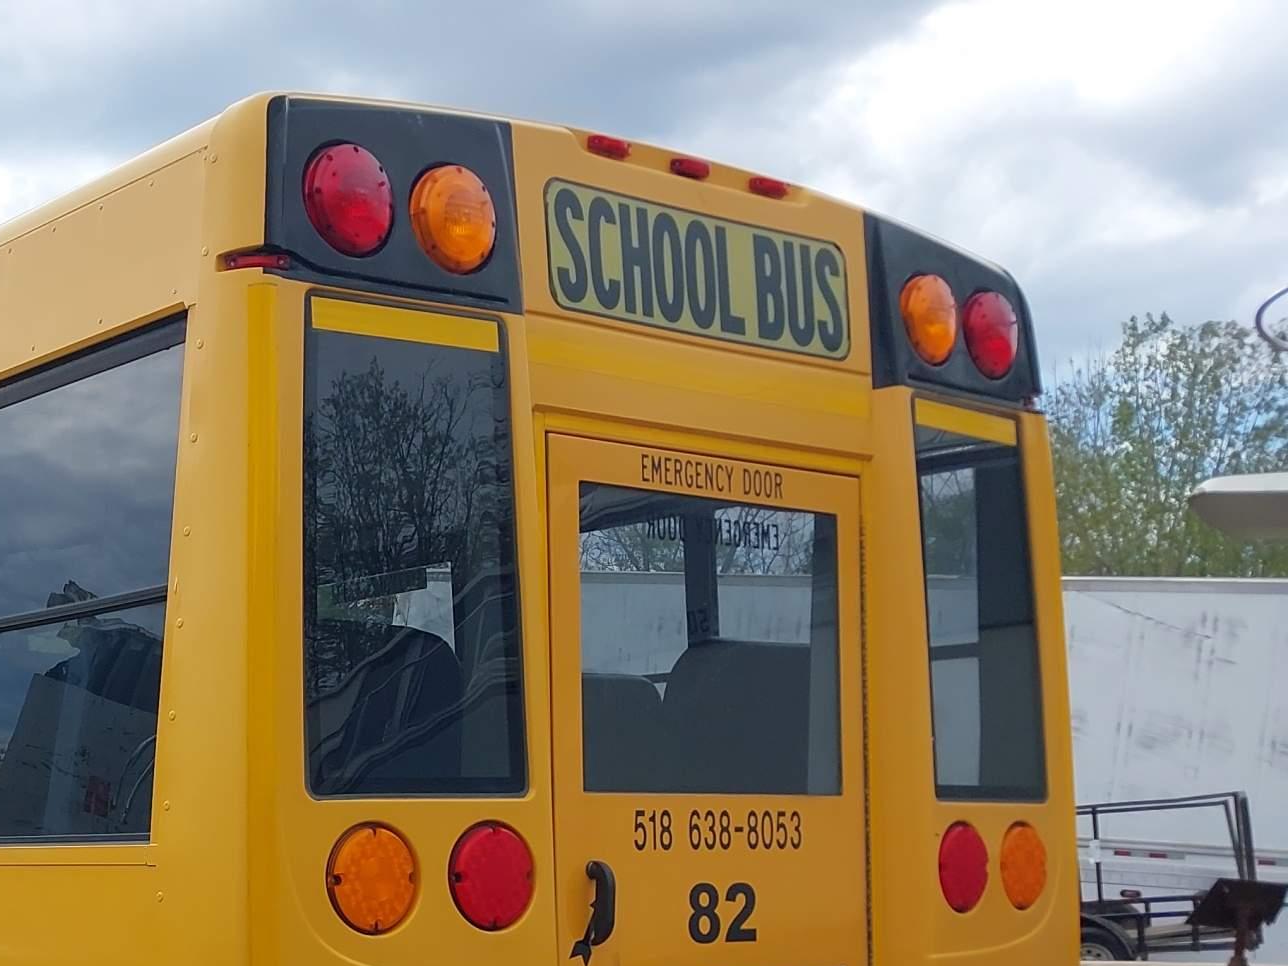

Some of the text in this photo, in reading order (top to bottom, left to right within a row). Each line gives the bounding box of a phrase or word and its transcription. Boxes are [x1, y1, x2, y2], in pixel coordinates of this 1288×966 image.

[554, 187, 843, 352] SCHOOL BUS
[641, 453, 784, 499] EMERGENCY DOOR
[633, 809, 802, 851] 518 638-8053
[688, 882, 758, 944] 82
